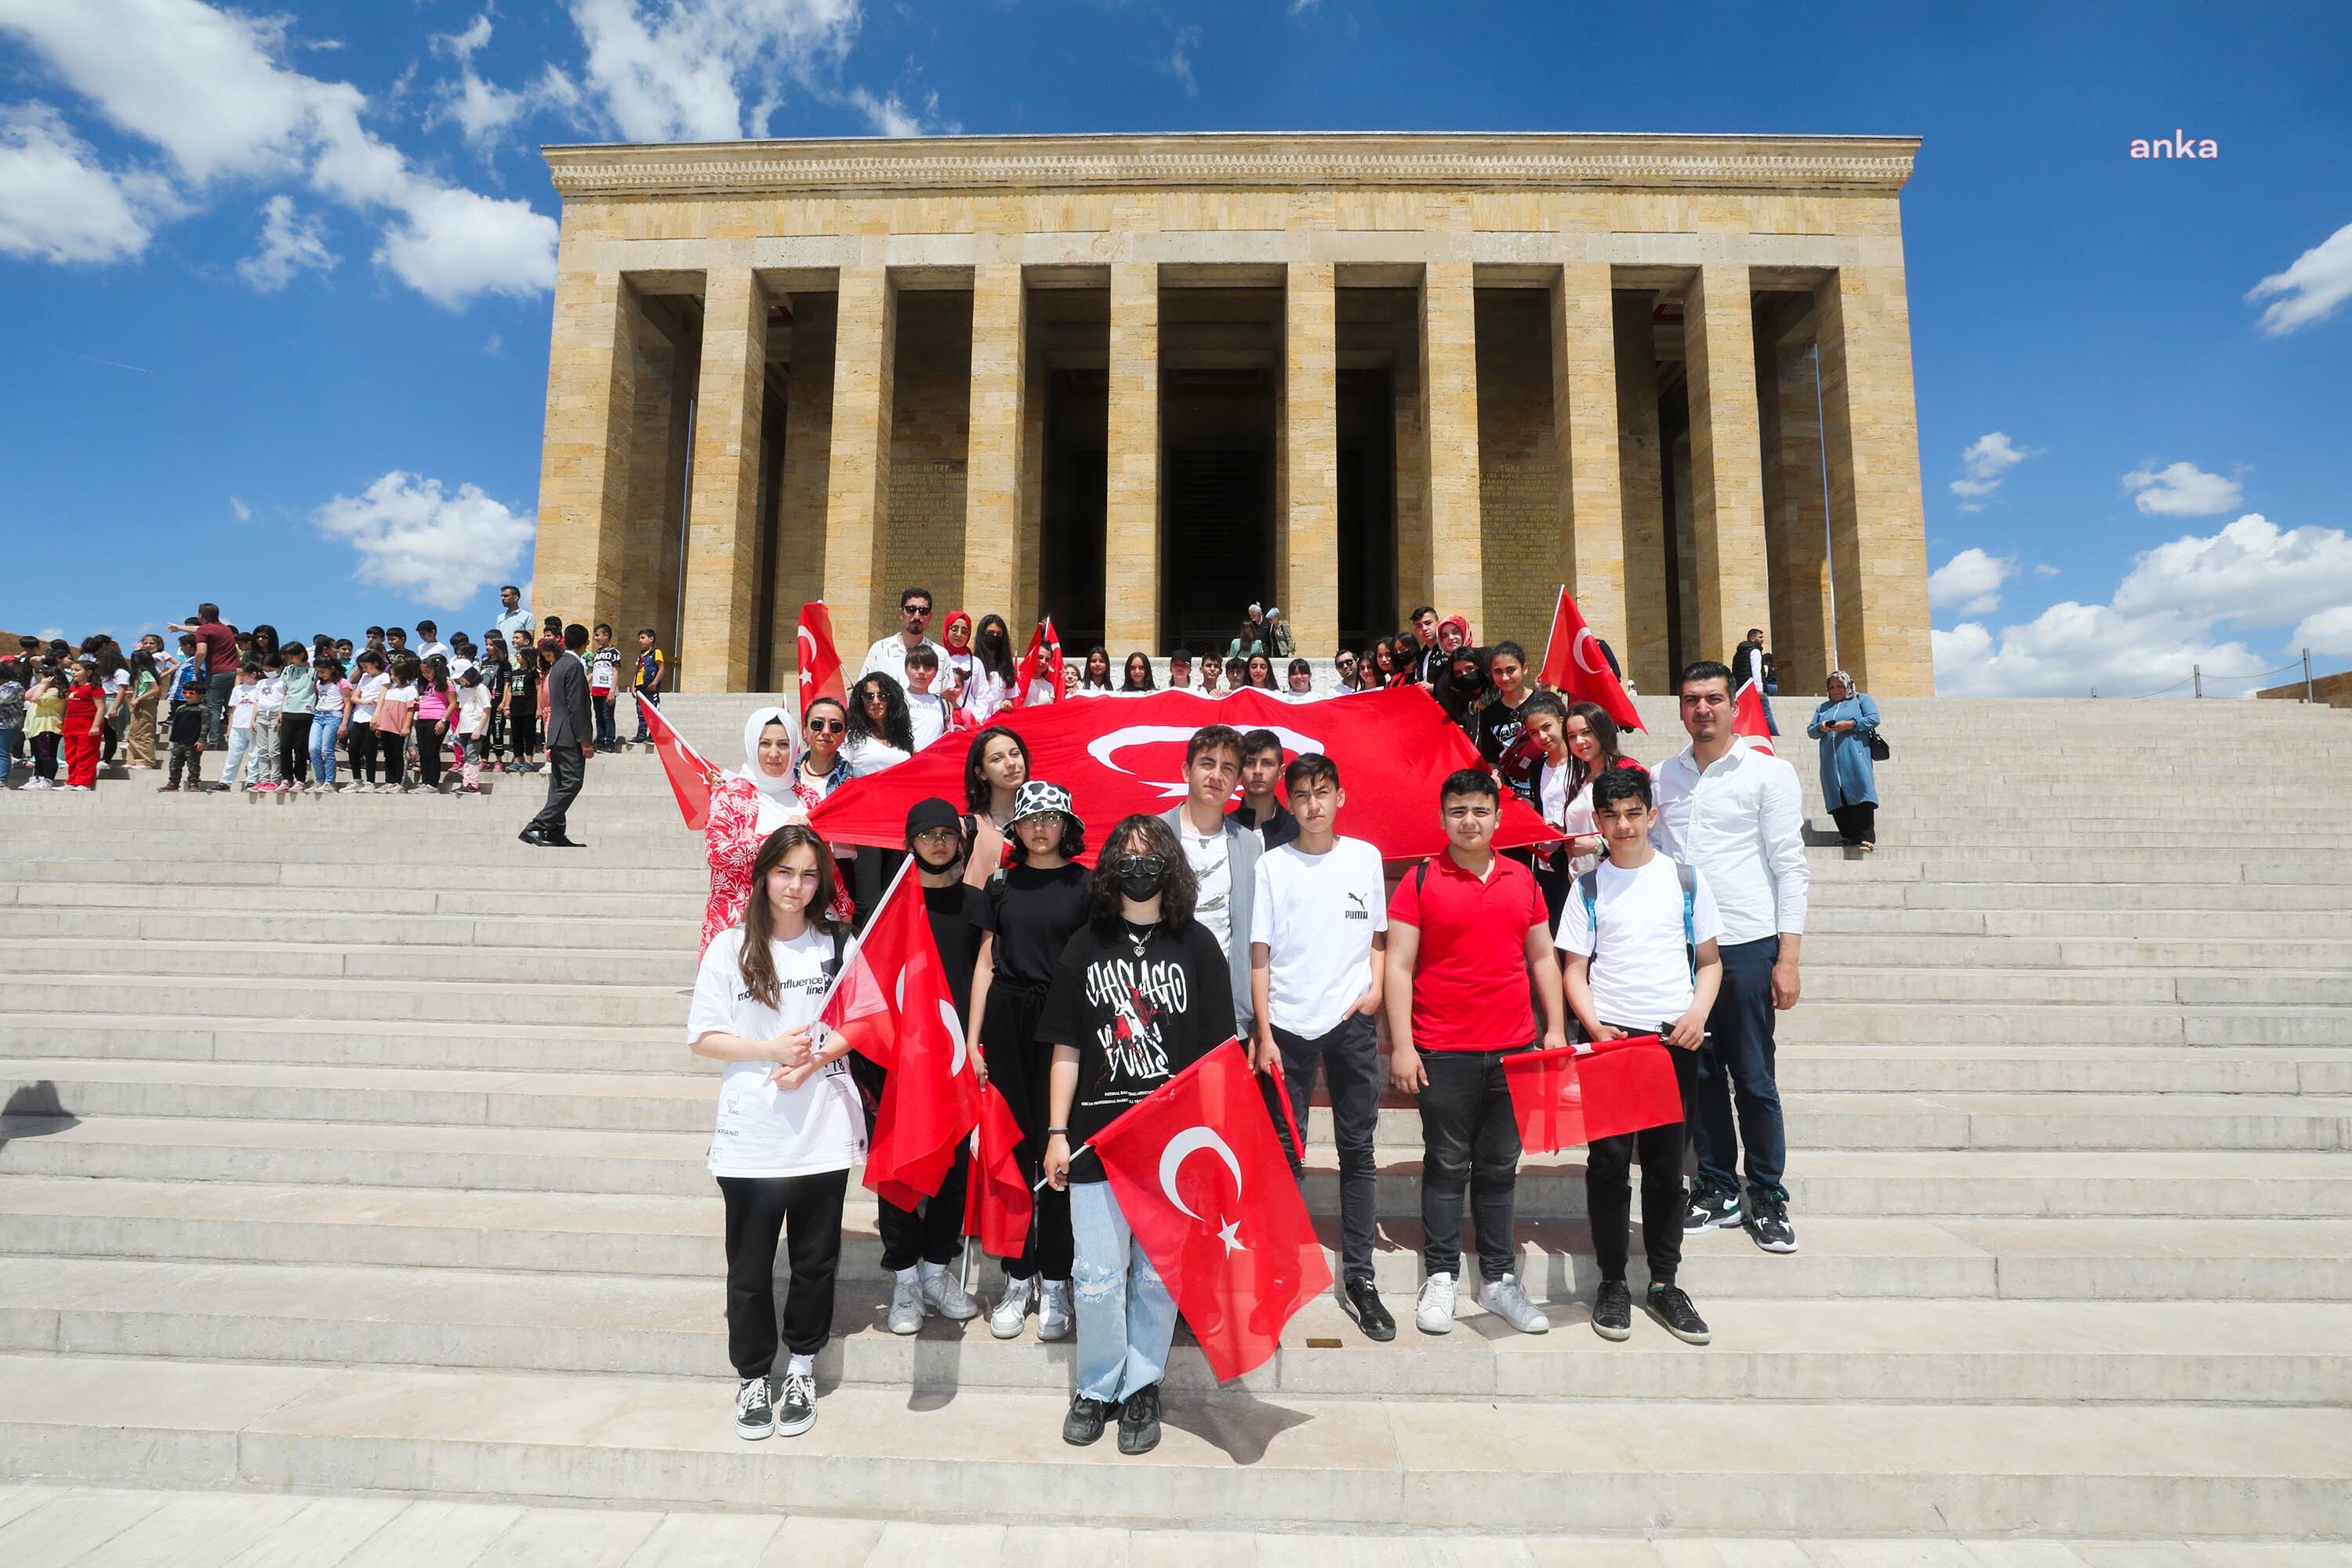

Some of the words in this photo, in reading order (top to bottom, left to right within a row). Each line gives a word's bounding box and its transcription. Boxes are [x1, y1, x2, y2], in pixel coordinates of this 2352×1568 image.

[593, 652, 612, 662] ARD
[1345, 910, 1368, 920] PUMA
[778, 976, 823, 990] influence
[806, 985, 823, 996] line
